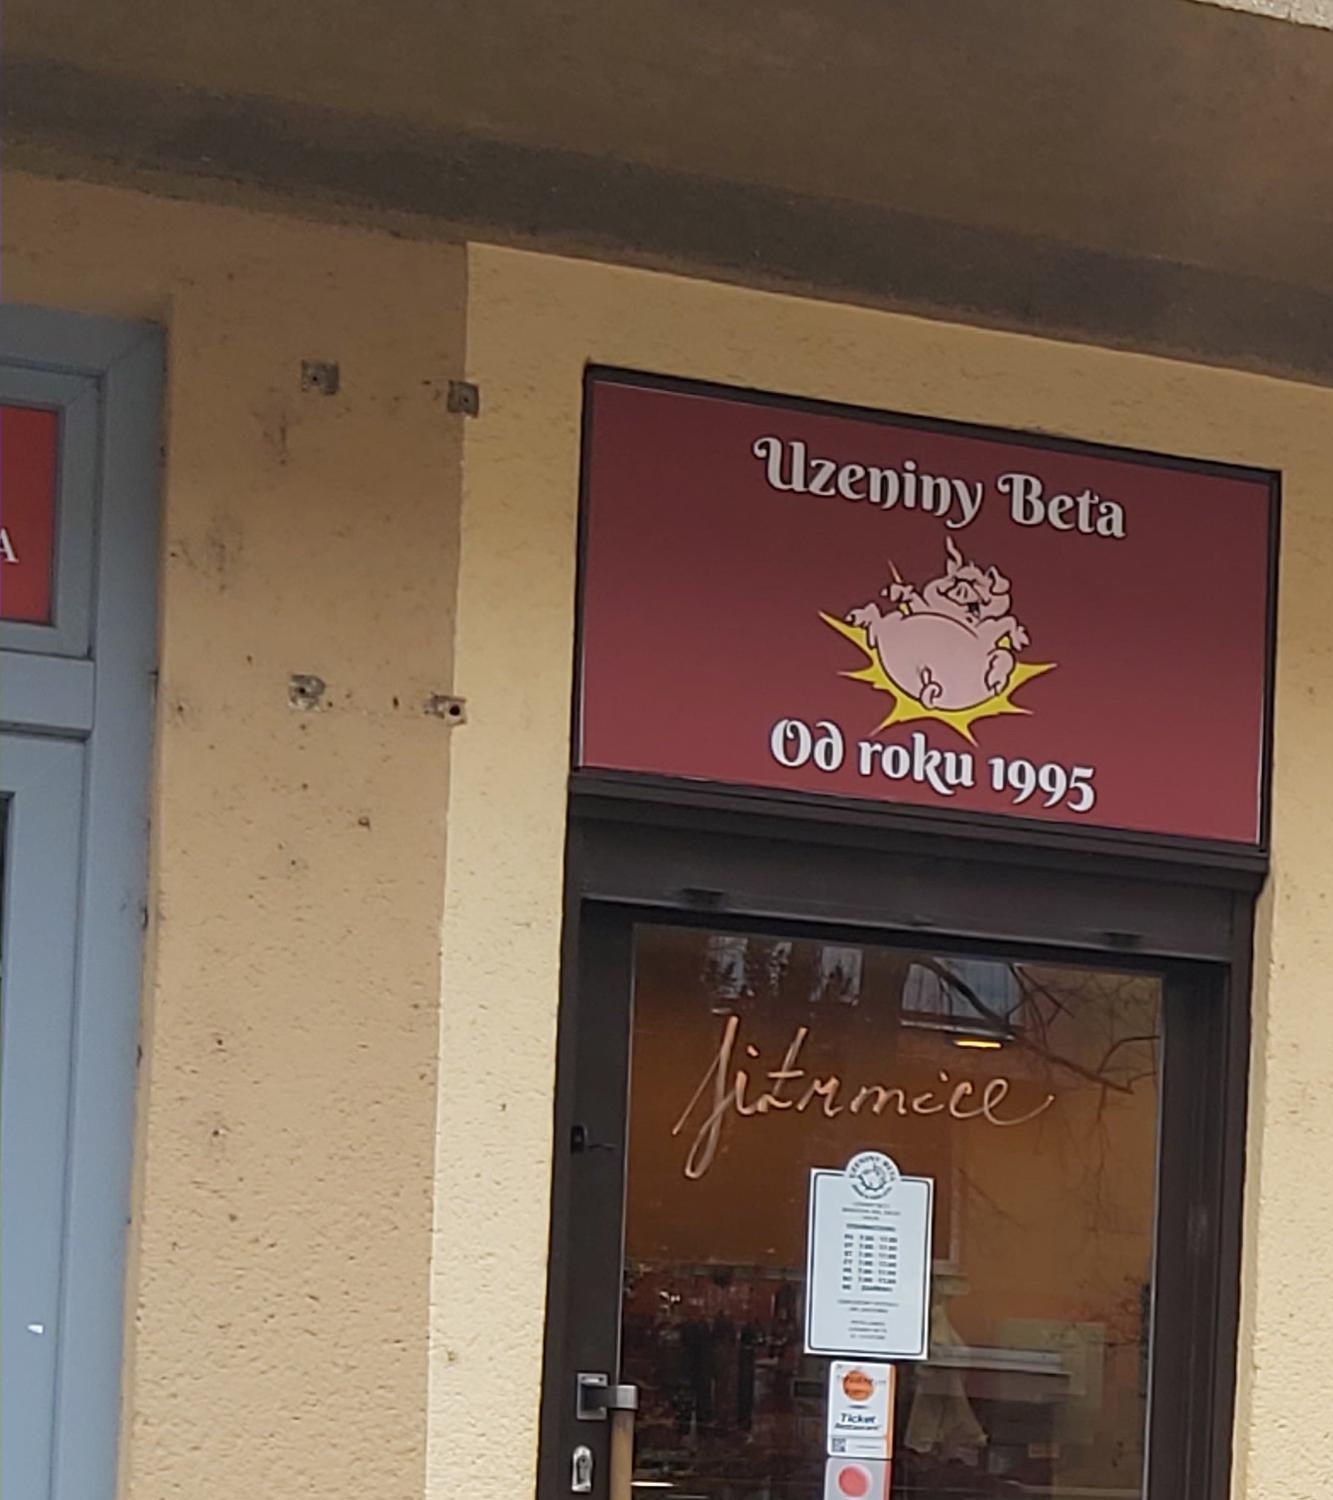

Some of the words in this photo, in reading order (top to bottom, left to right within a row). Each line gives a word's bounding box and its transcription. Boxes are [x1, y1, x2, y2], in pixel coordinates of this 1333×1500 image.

[753, 436, 983, 529] Uzeniny
[998, 472, 1126, 539] Beta
[770, 718, 844, 772] Od
[857, 732, 974, 795] roku
[988, 755, 1096, 813] 1995
[841, 1412, 876, 1424] Ticket
